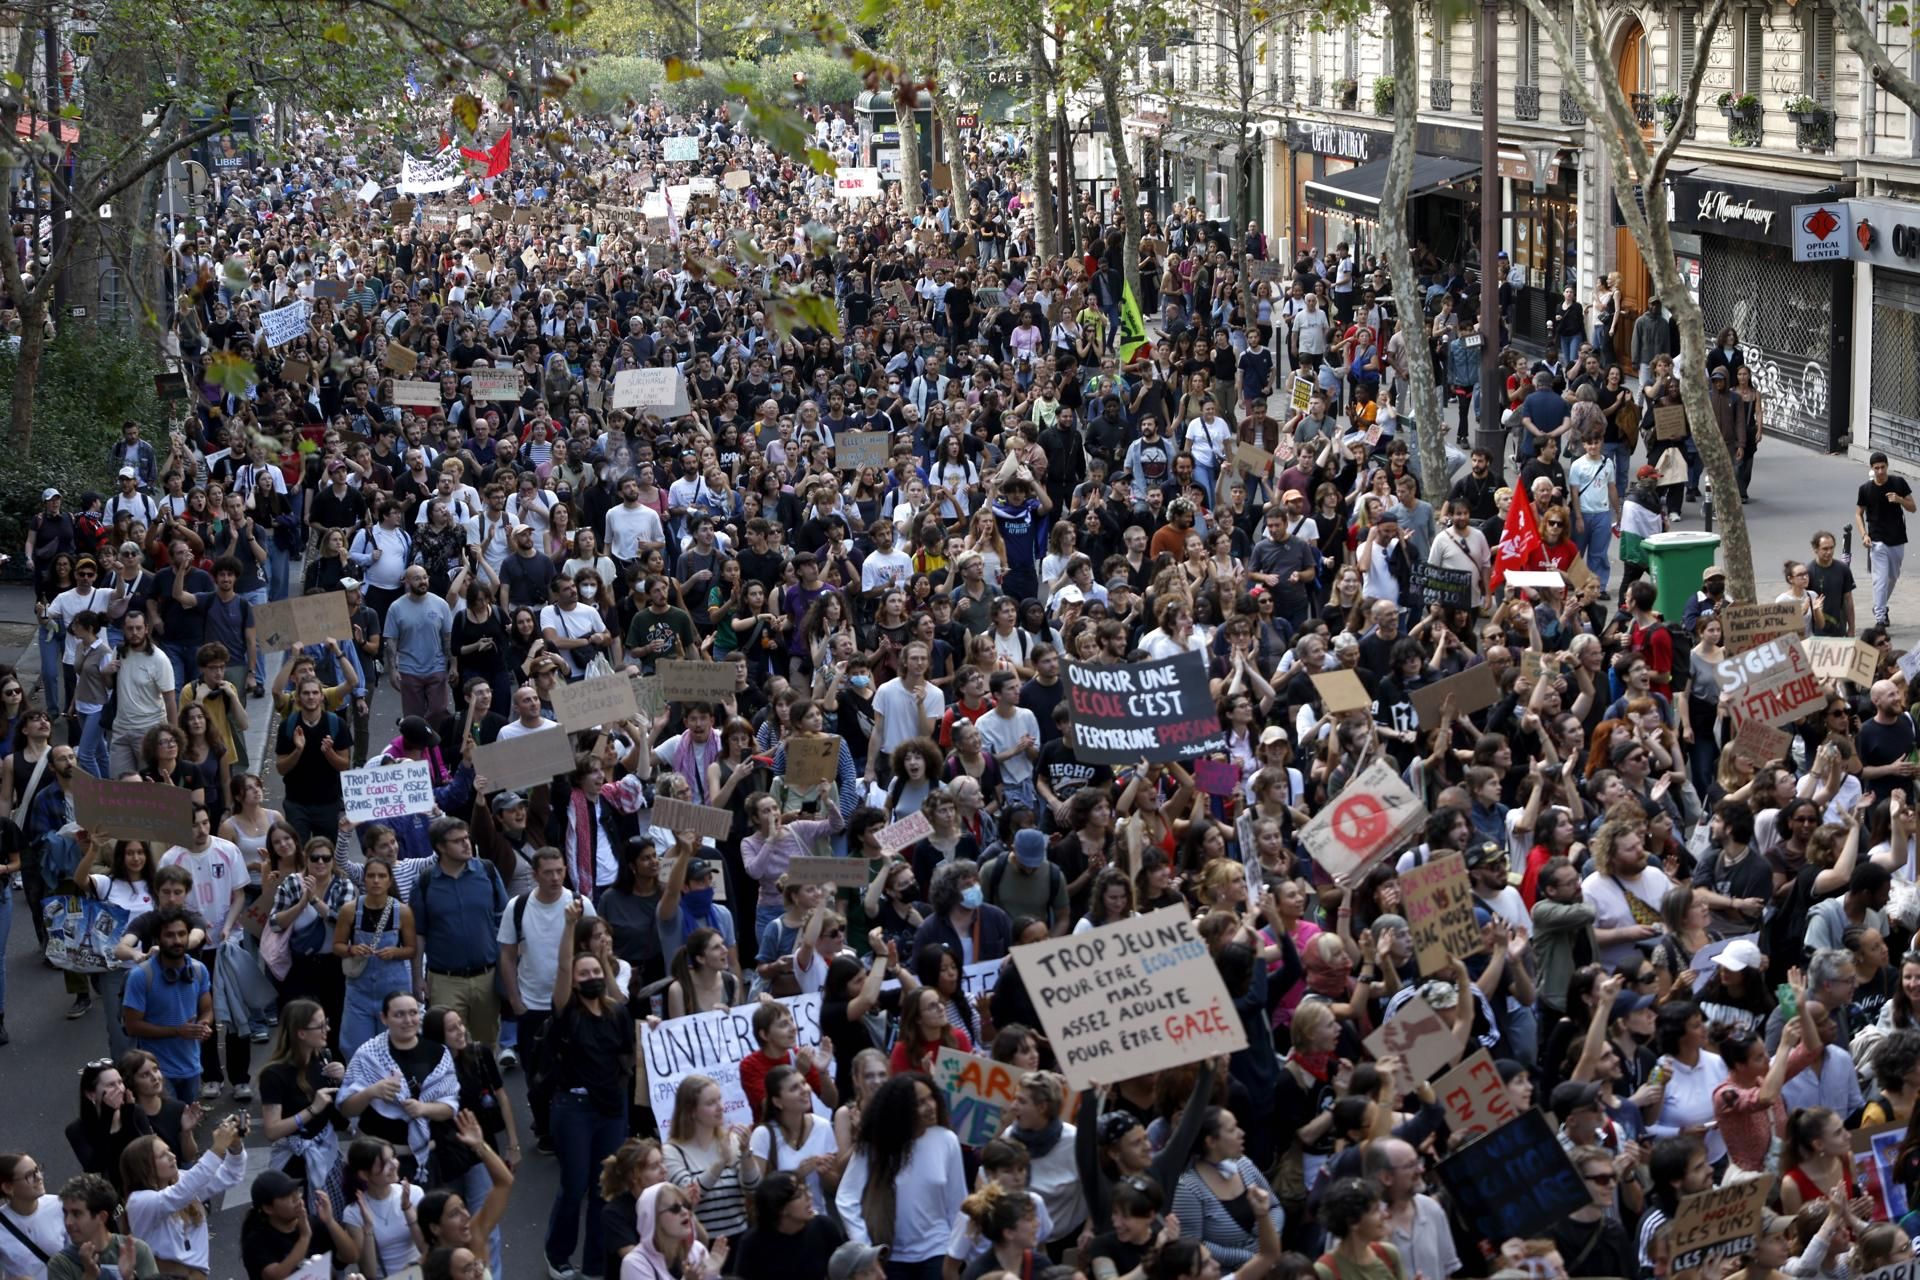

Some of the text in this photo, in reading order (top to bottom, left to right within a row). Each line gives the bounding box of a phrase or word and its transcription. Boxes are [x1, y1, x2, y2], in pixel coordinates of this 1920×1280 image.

[956, 117, 974, 126] TRO
[1312, 127, 1368, 160] OPTIC DUROC
[215, 158, 242, 166] LIBRE
[1697, 191, 1713, 221] Le
[1714, 191, 1745, 222] Manoir
[1743, 199, 1775, 235] luxury
[1806, 241, 1840, 250] OPTICAL
[1806, 250, 1840, 258] CENTER
[1068, 664, 1181, 692] OUVRIR UNE
[1071, 686, 1184, 718] ÉCOLE C'EST
[1157, 715, 1222, 745] PRISON
[344, 767, 428, 787] TROP JEUNES POUR
[344, 787, 362, 797] ÊTRE
[392, 794, 404, 803] SE
[372, 803, 407, 818] GAZER
[1422, 863, 1447, 885] VISE
[1450, 856, 1462, 876] LE
[1407, 896, 1432, 922] BAC
[1451, 882, 1467, 903] LA
[1414, 903, 1470, 952] BAC NOUS
[1037, 921, 1196, 979] TROP JEUNE
[1039, 978, 1094, 1008] POUR
[1095, 964, 1137, 988] ÊTRE
[1106, 978, 1152, 1004] MAIS
[1061, 987, 1191, 1041] ASSEZ ADULTE
[647, 995, 823, 1078] UNIVERÉS
[1067, 996, 1230, 1066] POUR ÊTRE GAZÉ
[1682, 1182, 1758, 1218] AIMONS
[1702, 1200, 1748, 1223] NOUS
[1676, 1210, 1754, 1246] LES UNS
[1674, 1249, 1702, 1271] LES
